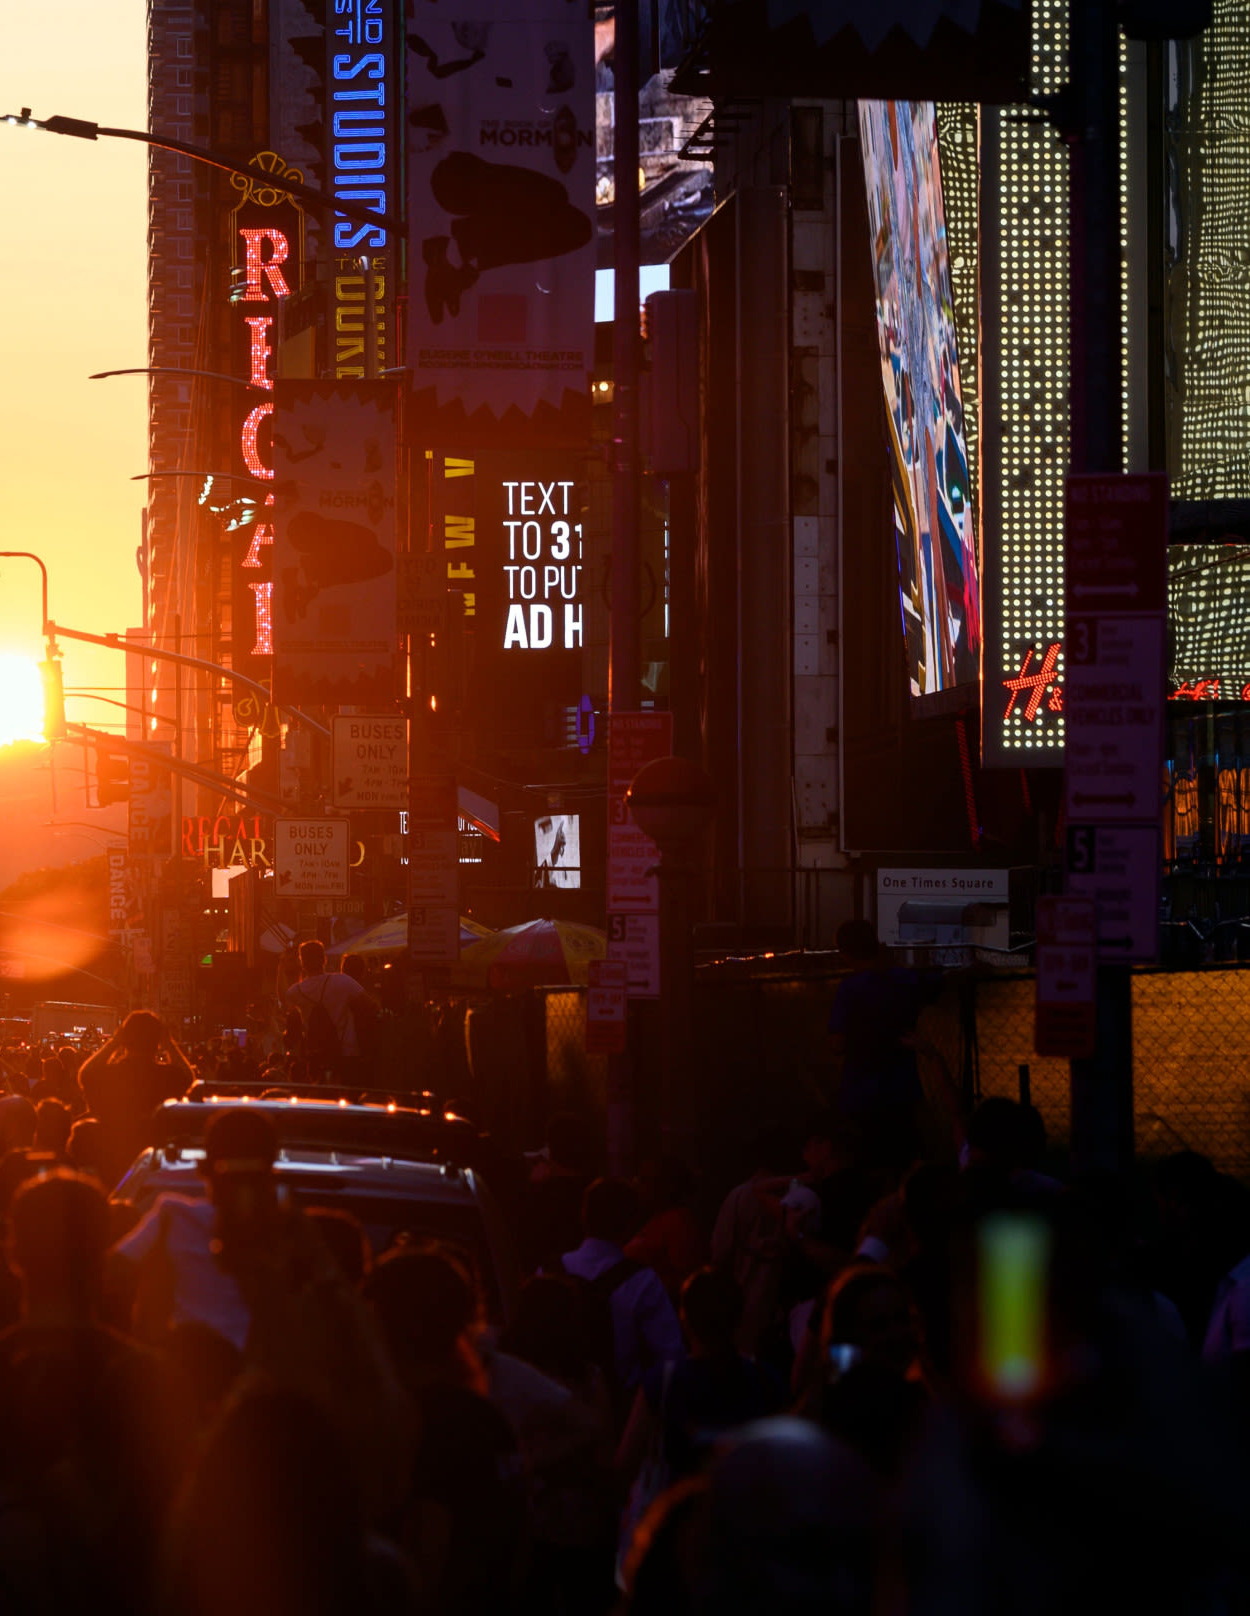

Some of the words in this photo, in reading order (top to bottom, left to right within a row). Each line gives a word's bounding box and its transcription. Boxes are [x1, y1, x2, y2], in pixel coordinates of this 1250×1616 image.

[333, 54, 386, 249] STUDIOS
[502, 481, 574, 515] TEXT
[502, 521, 541, 560] TO
[503, 565, 536, 600] TO
[503, 604, 553, 649] AD
[1074, 621, 1090, 661] 3
[350, 724, 404, 740] BUSES
[356, 744, 397, 760] ONLY
[132, 760, 150, 842] DANCE
[290, 826, 334, 839] BUSES
[294, 843, 329, 855] ONLY
[1072, 829, 1089, 870] 5
[110, 855, 127, 921] DANCE
[883, 877, 907, 888] One
[912, 877, 947, 888] Times
[952, 877, 994, 890] Square
[613, 915, 623, 940] 5
